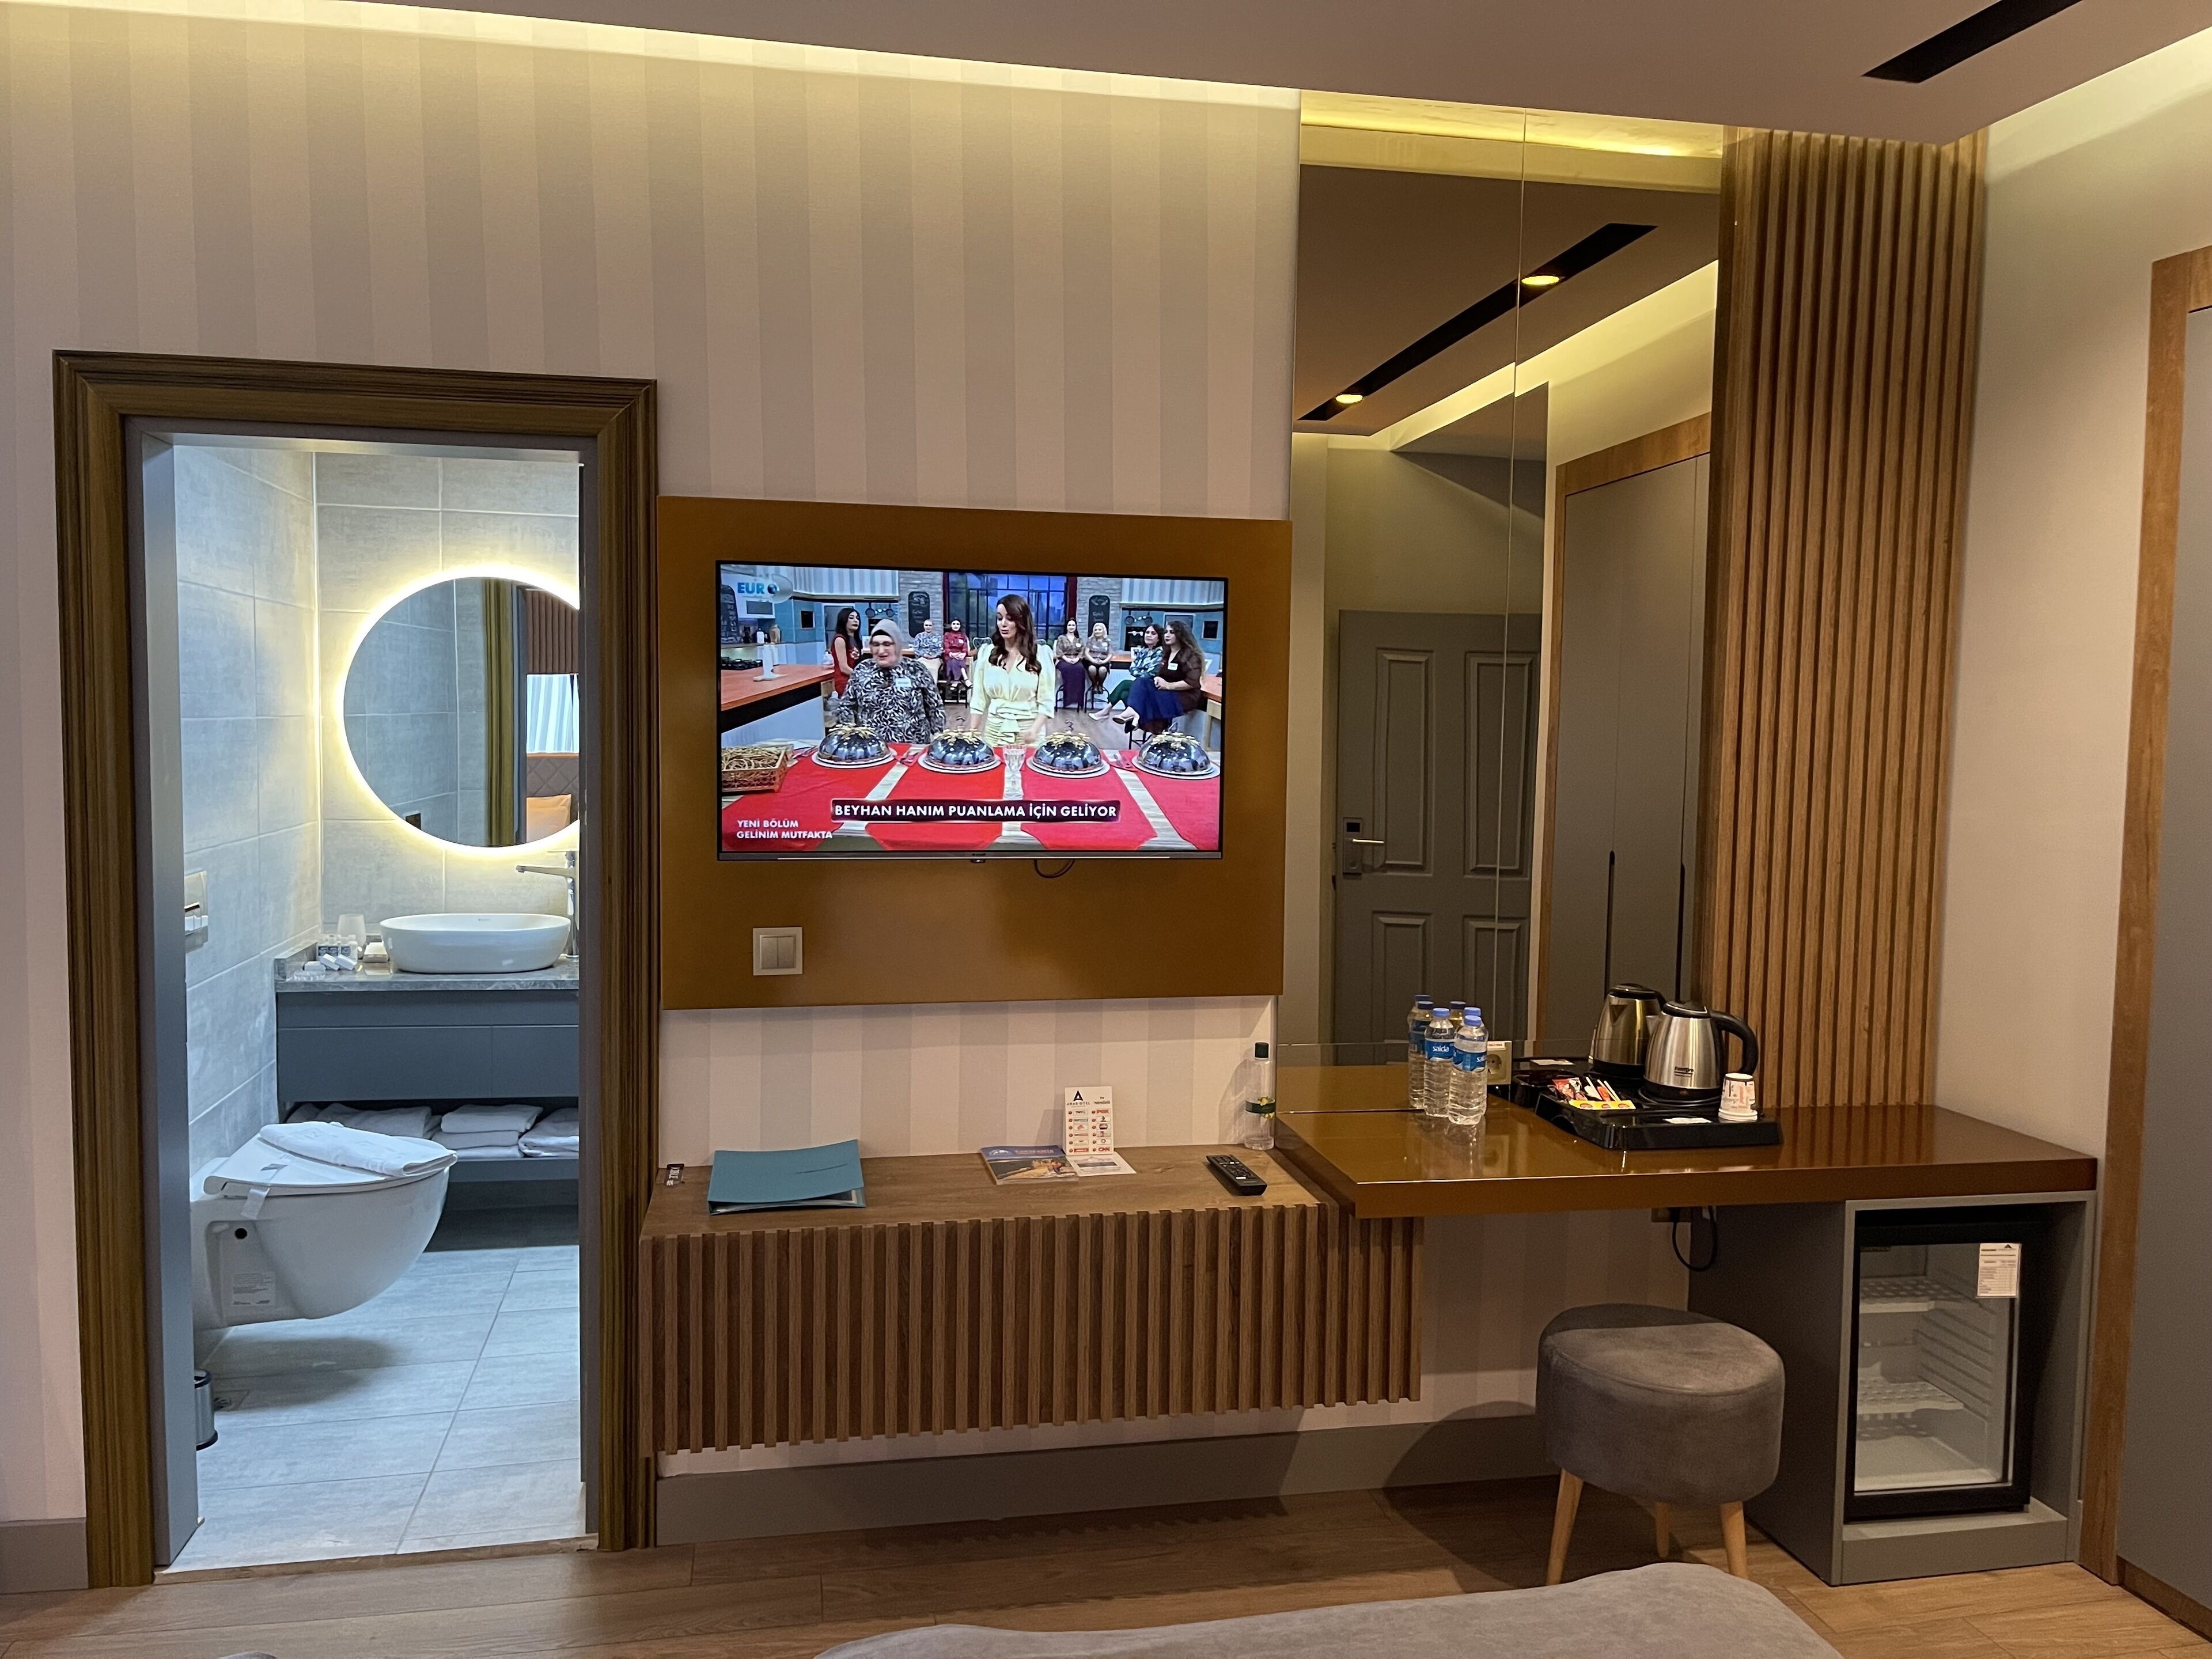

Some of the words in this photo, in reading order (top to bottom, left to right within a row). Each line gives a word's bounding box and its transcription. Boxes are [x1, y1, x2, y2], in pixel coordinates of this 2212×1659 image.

[835, 805, 892, 816] BEYHAN
[896, 805, 944, 816] HANIM
[950, 805, 1025, 817] PUANLAMA
[1029, 802, 1056, 819] İÇİN
[1060, 803, 1116, 817] GELİYOR
[737, 817, 760, 828] YENİ
[763, 817, 799, 828] BÖLÜM
[736, 830, 779, 839] GELİNİM
[781, 831, 833, 839] MUTFAKTA
